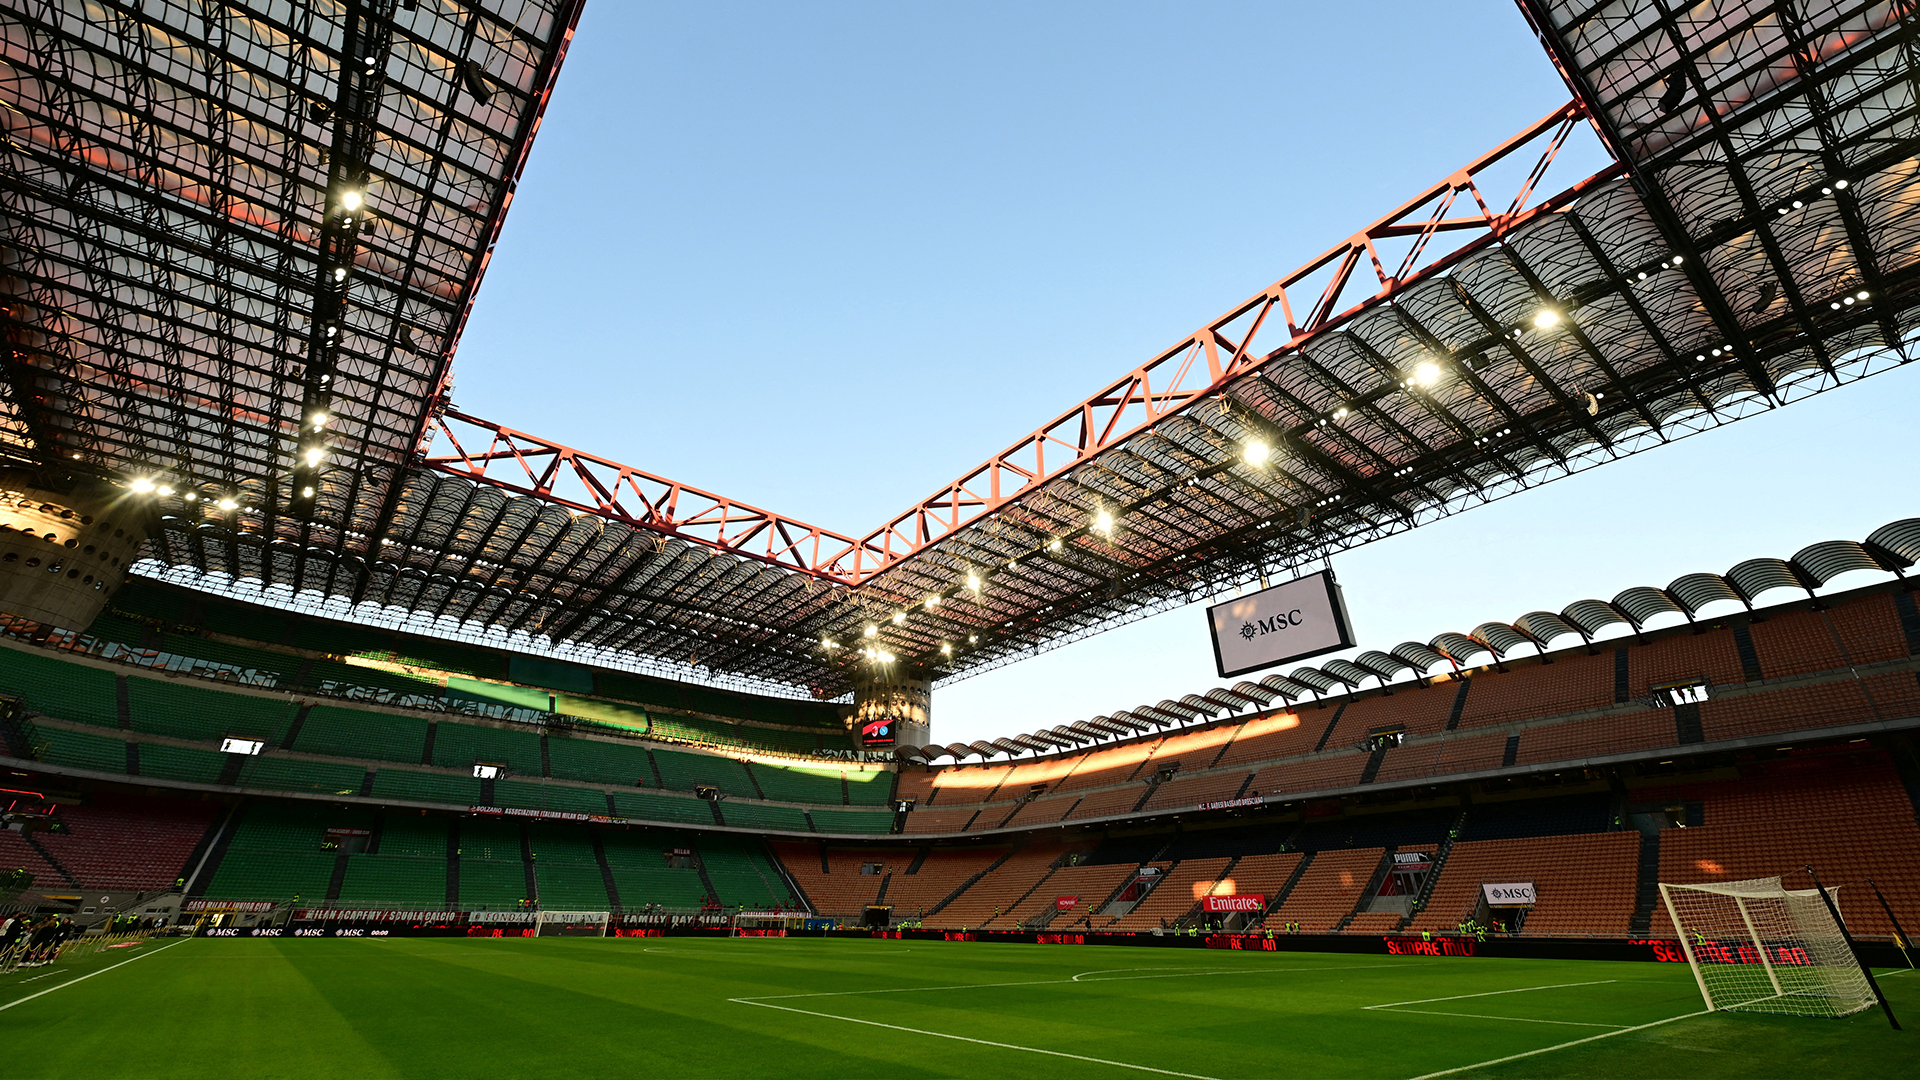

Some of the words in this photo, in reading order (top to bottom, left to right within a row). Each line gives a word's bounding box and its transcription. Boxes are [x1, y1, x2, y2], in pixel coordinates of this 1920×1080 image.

[1258, 609, 1303, 635] MSC
[504, 807, 540, 817] ASSOCIAZIONE
[561, 812, 577, 820] MILAN
[1394, 853, 1420, 863] PUMA
[1502, 888, 1531, 899] MSC
[187, 901, 206, 911] CASA
[255, 903, 271, 912] CLUB
[1209, 896, 1258, 910] Emirates
[305, 910, 336, 920] MILAN
[389, 911, 423, 921] SCUOLA
[425, 912, 455, 921] CALCIO
[624, 914, 667, 924] FAMILY
[671, 915, 693, 924] DAY
[466, 928, 504, 937] SEMPRE
[615, 929, 646, 937] SEMPRE
[739, 929, 765, 937] SEMPRE
[1036, 934, 1062, 944] SEMPRE
[1063, 935, 1084, 945] MILAN
[1205, 937, 1243, 950] SEMPRE
[1244, 938, 1277, 951] MILAN
[1387, 941, 1441, 956] SEMPRE
[1653, 945, 1735, 964] SEMPRE
